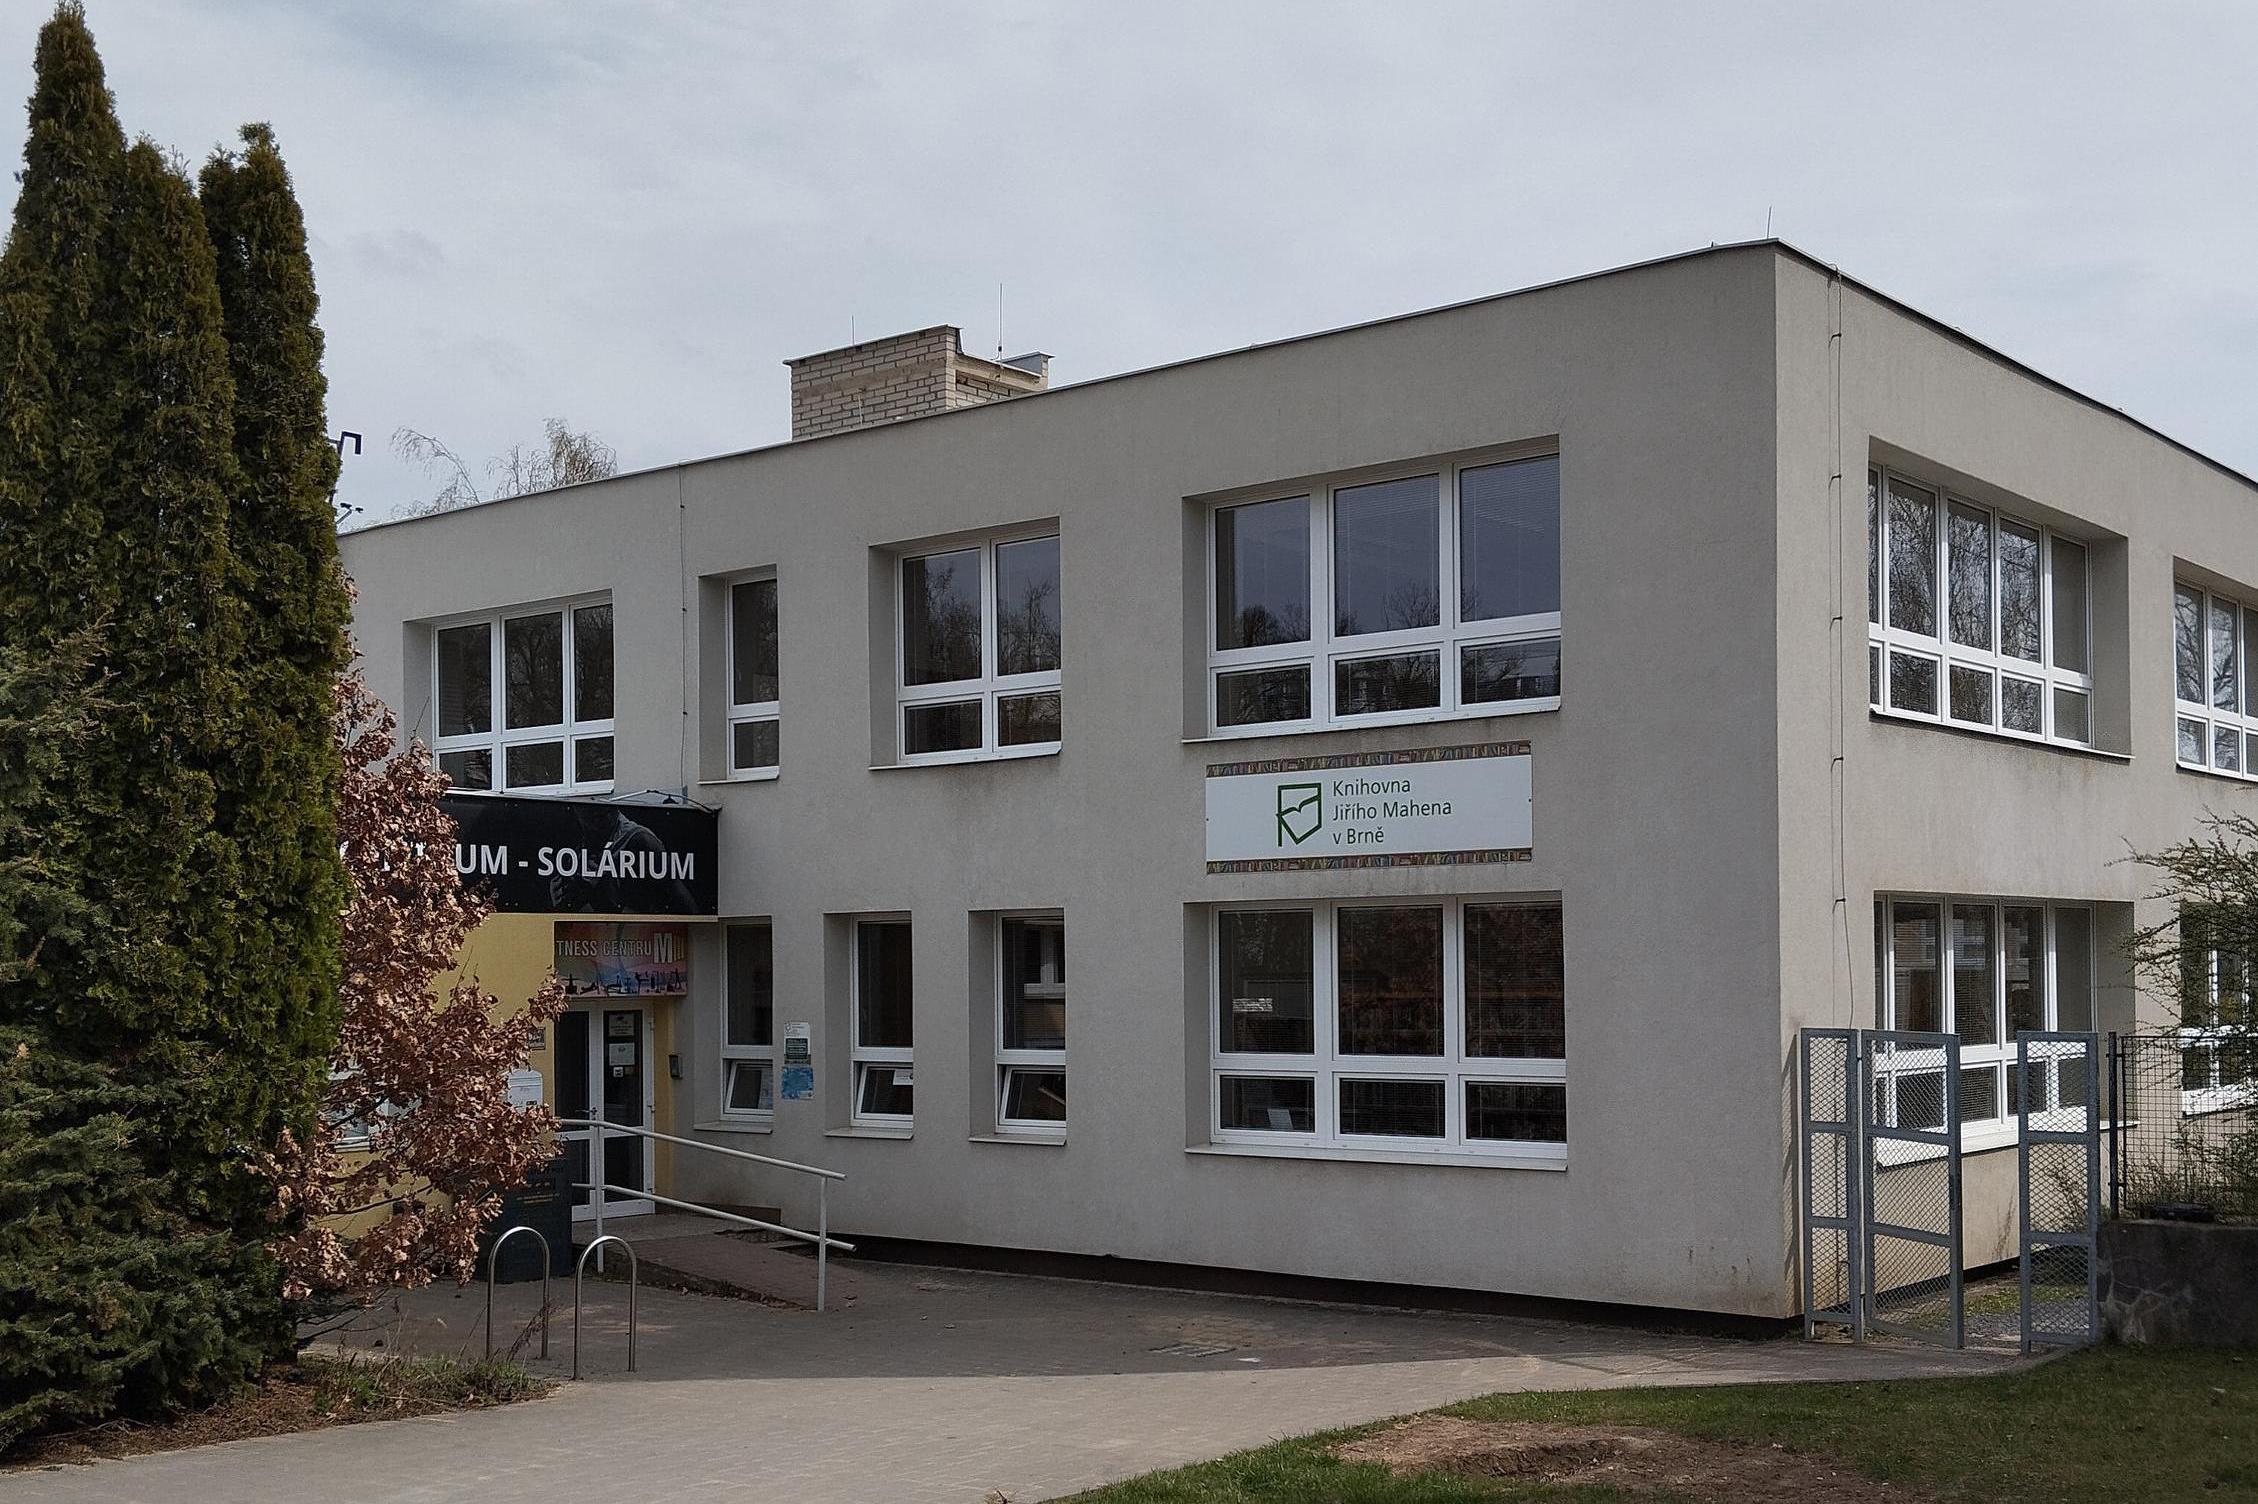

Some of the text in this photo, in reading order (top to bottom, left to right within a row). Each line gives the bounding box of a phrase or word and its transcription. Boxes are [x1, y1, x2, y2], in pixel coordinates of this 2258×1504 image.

[1333, 778, 1411, 797] Knihovna
[1332, 799, 1452, 821] Jiřího Mahena
[1332, 826, 1384, 845] v Brně
[537, 841, 695, 881] SOLÁRIUM
[556, 940, 598, 957] TNESS
